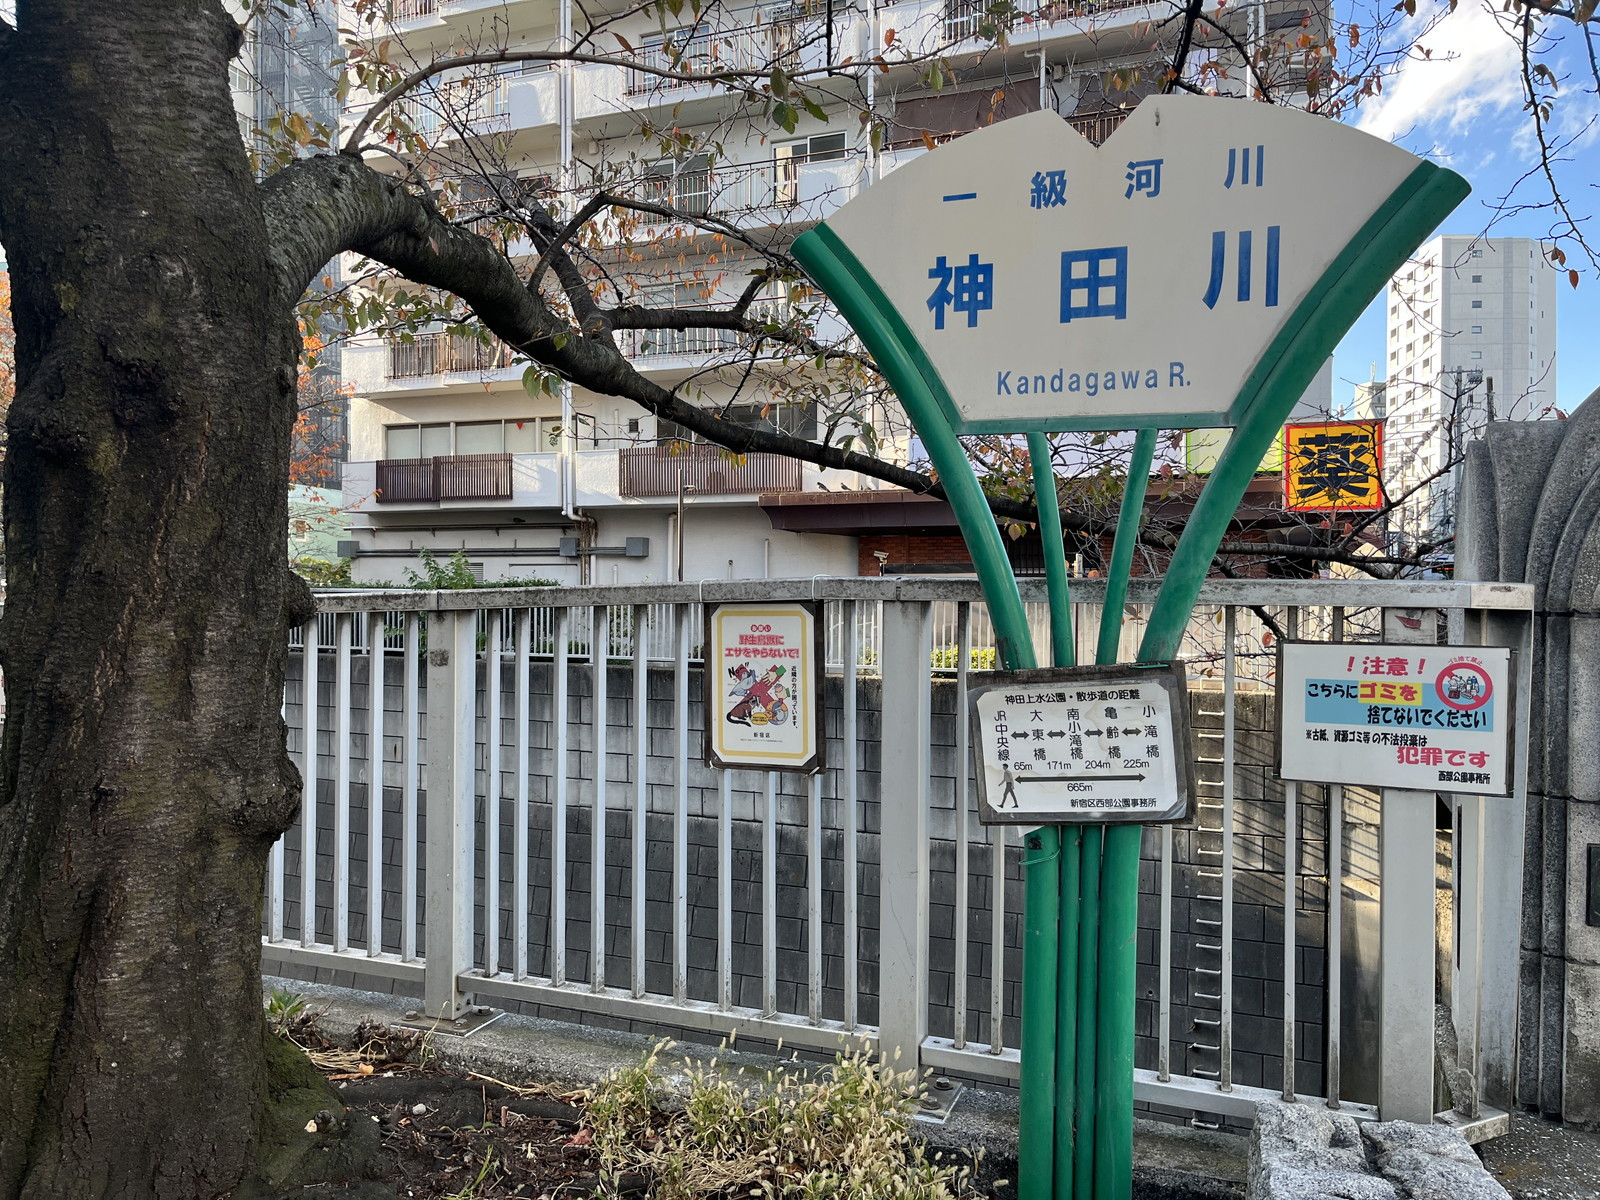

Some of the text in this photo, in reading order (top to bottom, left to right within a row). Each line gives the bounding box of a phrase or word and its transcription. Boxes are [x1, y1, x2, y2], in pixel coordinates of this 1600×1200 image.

[942, 145, 1265, 210] 一級河川
[926, 225, 1282, 330] 神田川
[997, 362, 1191, 397] Kandagawa R.
[1297, 433, 1370, 498] 薬
[1005, 689, 1141, 705] 神田上水公園・散歩道の距離
[1307, 683, 1418, 701] こちらにゴミを
[1142, 705, 1160, 758] 小滝橋
[1367, 705, 1487, 729] 捨てないでください
[1030, 709, 1047, 761] 大東橋
[1066, 708, 1084, 760] 南小滝橋
[1104, 706, 1121, 759] 亀齢橋
[1014, 759, 1150, 771] 65m 171m 204m 225m
[1396, 746, 1491, 768] 犯罪です
[1067, 783, 1093, 792] 665m
[1438, 770, 1491, 784] 西部公園事務所
[1070, 798, 1157, 808] 新宿区西部公園事務所
